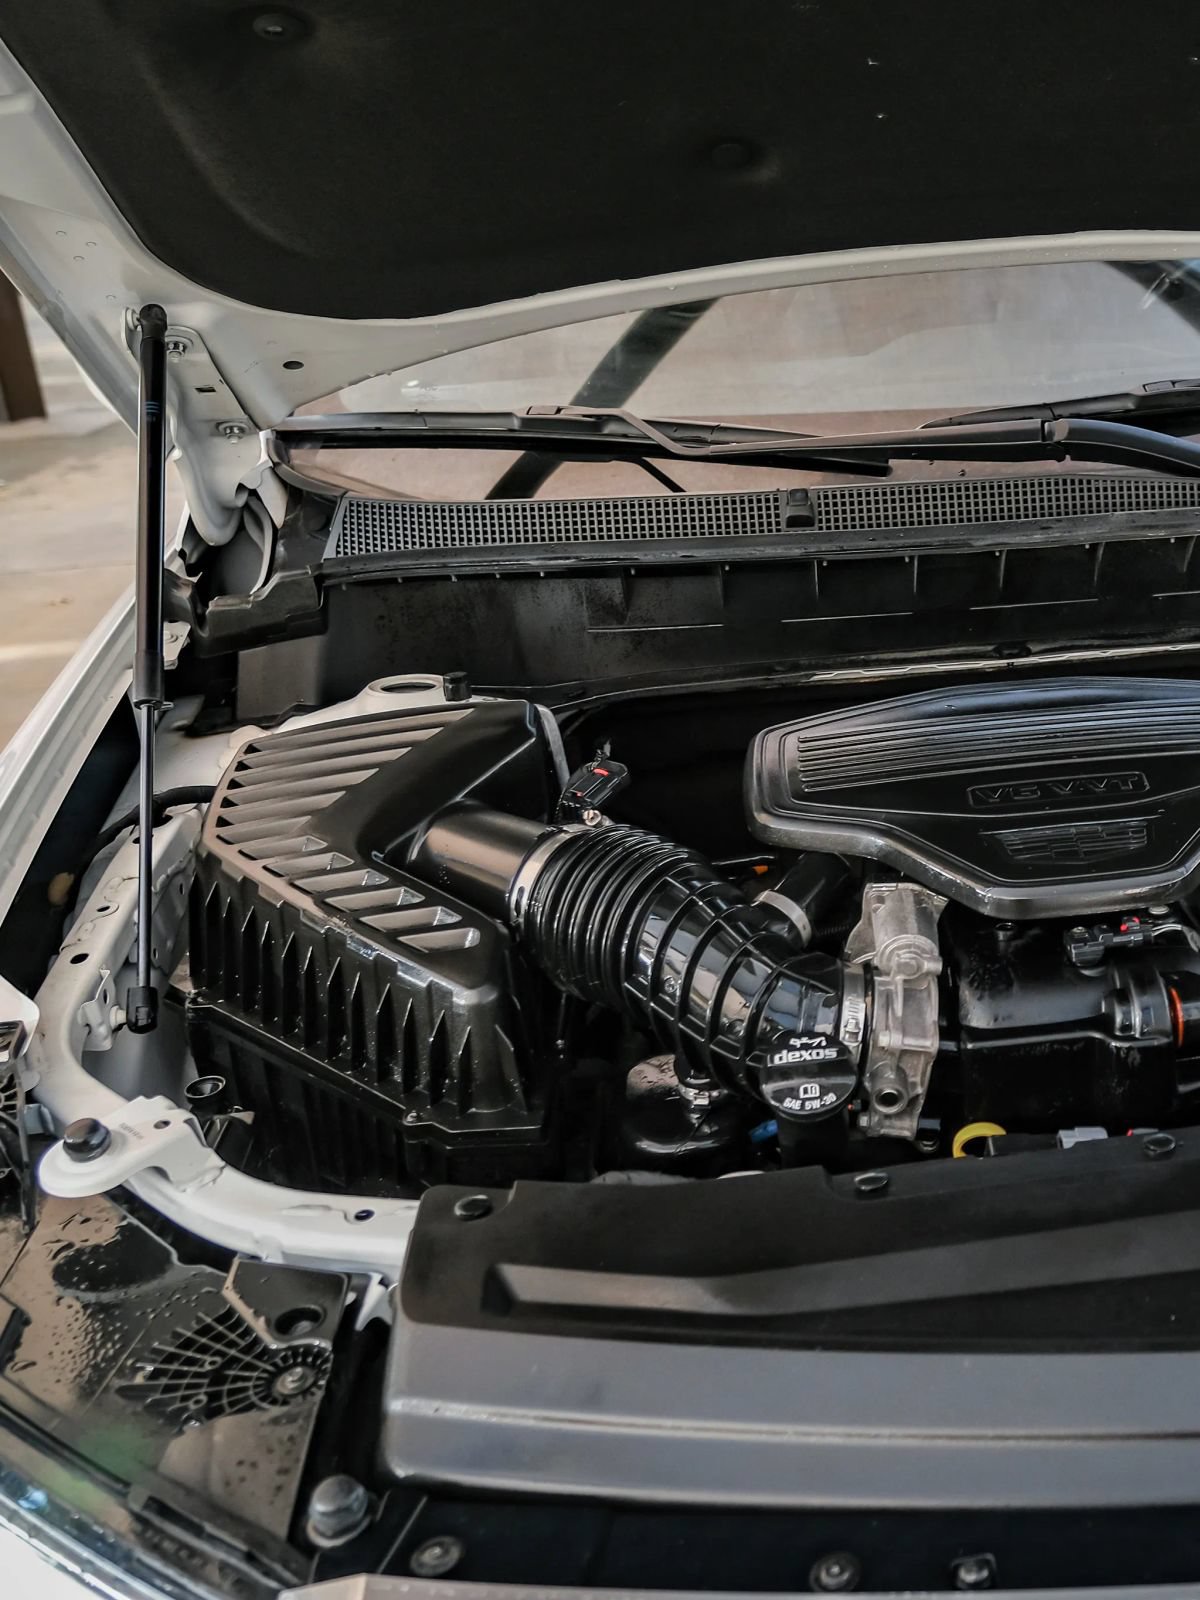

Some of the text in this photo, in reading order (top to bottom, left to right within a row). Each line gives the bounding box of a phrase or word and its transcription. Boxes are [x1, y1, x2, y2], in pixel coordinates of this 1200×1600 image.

[747, 889, 809, 931] DieHard
[773, 1047, 840, 1065] dexos
[783, 1092, 837, 1111] SAE 5W-30
